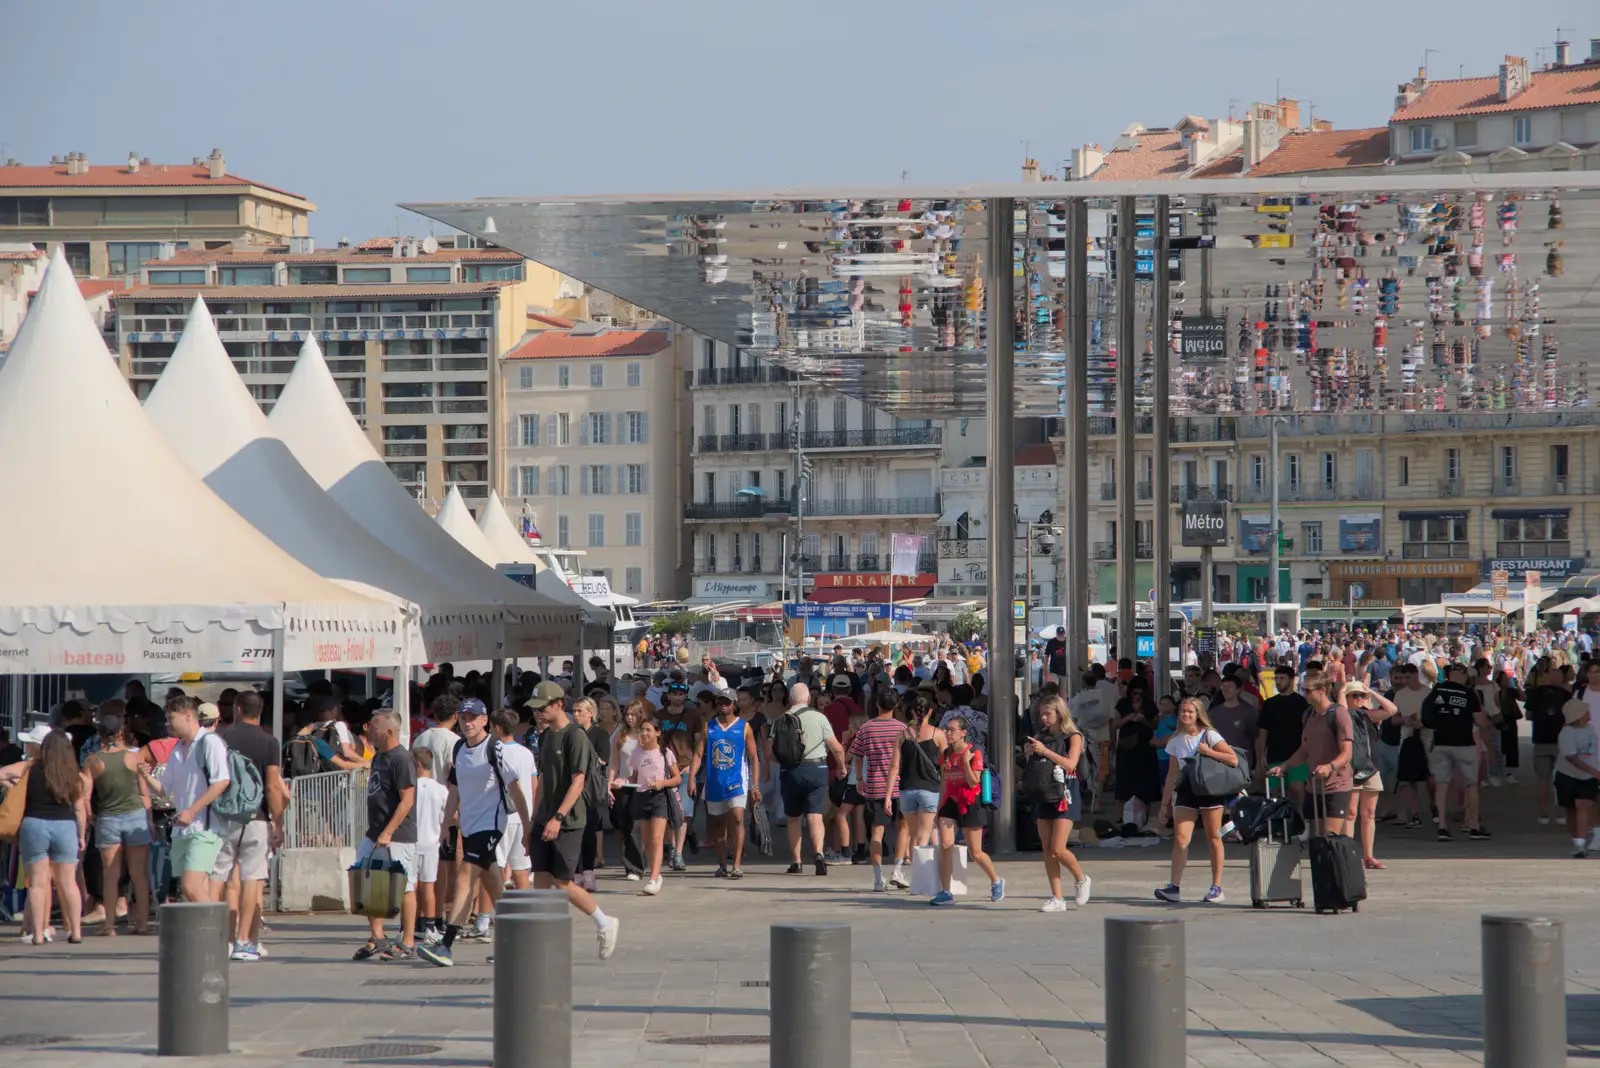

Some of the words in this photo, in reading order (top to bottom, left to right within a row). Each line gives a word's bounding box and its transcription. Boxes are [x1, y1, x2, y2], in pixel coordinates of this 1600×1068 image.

[320, 328, 488, 342] RESIDENCE
[1185, 513, 1225, 529] Métro
[1338, 566, 1381, 576] SANDWICH
[1385, 565, 1407, 575] SHOP
[1422, 563, 1465, 574] EGGPLANT
[1491, 559, 1572, 570] RESTAURANT
[964, 562, 987, 581] Peti
[833, 575, 917, 587] MIRAMAR
[1134, 620, 1155, 628] ieux-P
[151, 636, 184, 645] Autres
[1138, 640, 1155, 652] M1
[0, 648, 29, 657] ernet
[143, 650, 192, 660] Passagers
[241, 648, 276, 658] RTM
